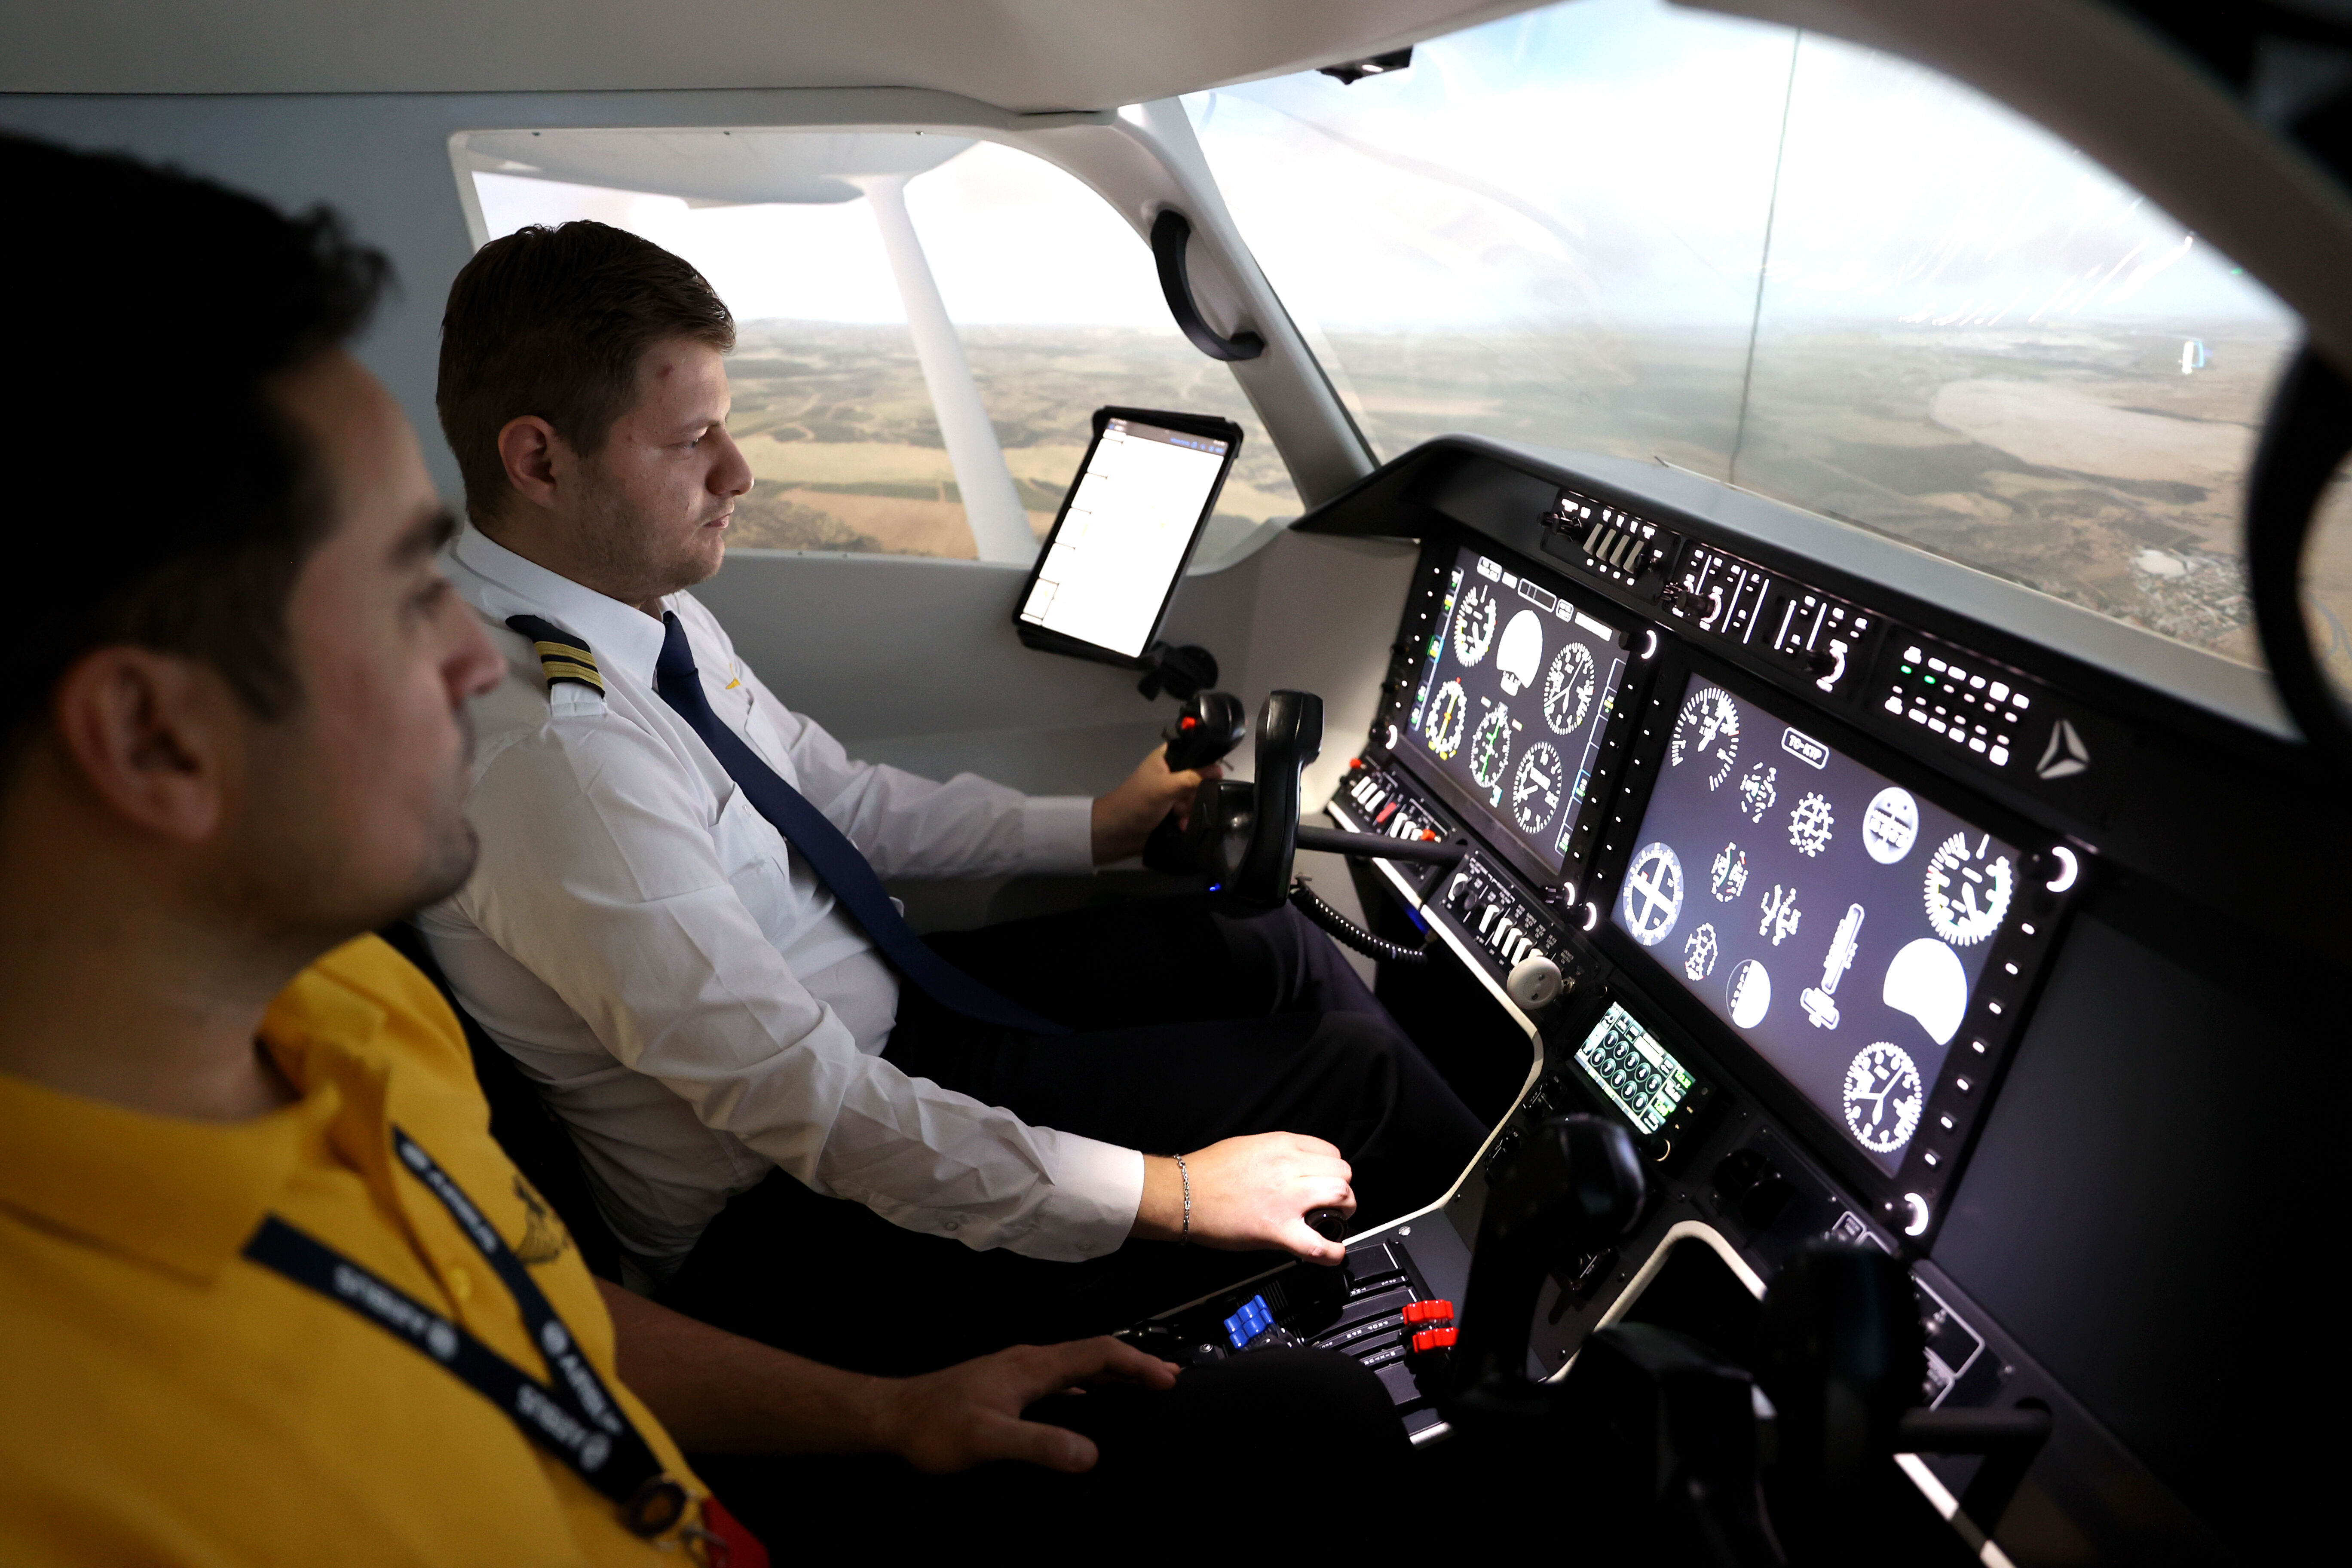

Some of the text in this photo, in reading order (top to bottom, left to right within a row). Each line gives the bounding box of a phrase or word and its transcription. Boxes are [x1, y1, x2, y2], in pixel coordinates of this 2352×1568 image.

[1594, 1053, 1602, 1062] 6
[1605, 1063, 1612, 1072] 7
[1615, 1075, 1622, 1084] 8
[1625, 1086, 1632, 1095] 9
[1608, 1035, 1657, 1089] 1 2 3 4 5
[1347, 1321, 1388, 1339] PROP RPM
